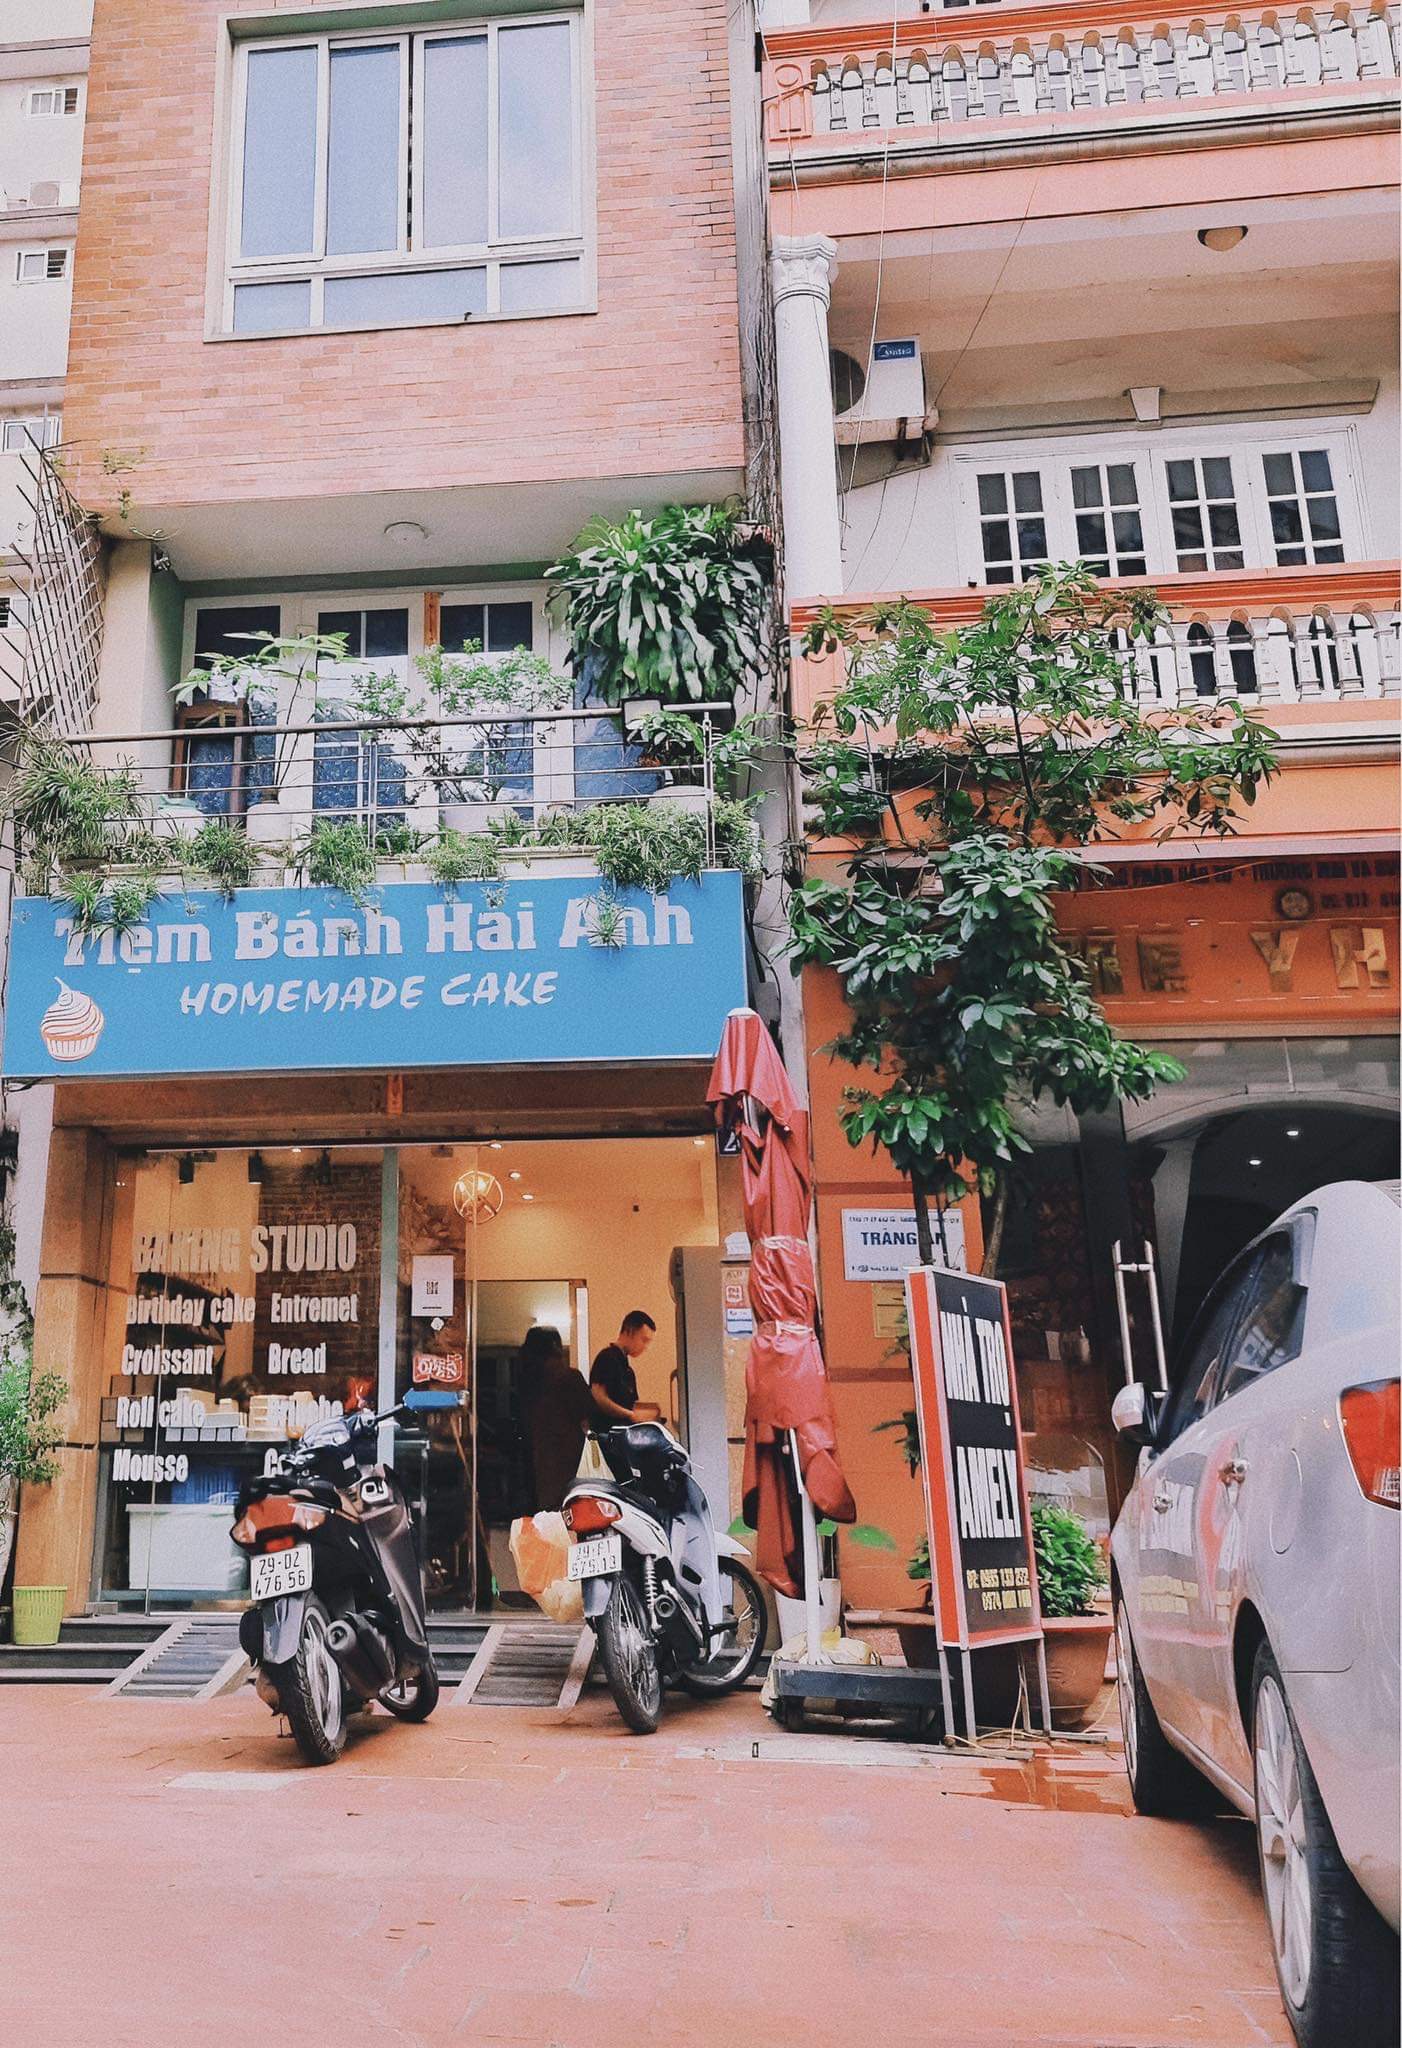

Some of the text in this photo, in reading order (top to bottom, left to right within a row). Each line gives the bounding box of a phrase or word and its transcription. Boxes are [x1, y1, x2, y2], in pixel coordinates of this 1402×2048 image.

[234, 904, 403, 960] Bánh
[179, 970, 559, 1017] HOMEMADE CAKE
[131, 1223, 357, 1274] BAKING STUDIO
[126, 1292, 256, 1326] Birthday cake
[271, 1291, 358, 1323] Entremet
[121, 1343, 214, 1376] Croissant
[268, 1342, 327, 1375] Bread
[116, 1396, 206, 1428] Roll cake
[112, 1449, 189, 1483] Mousse
[955, 1446, 1023, 1539] AMELY
